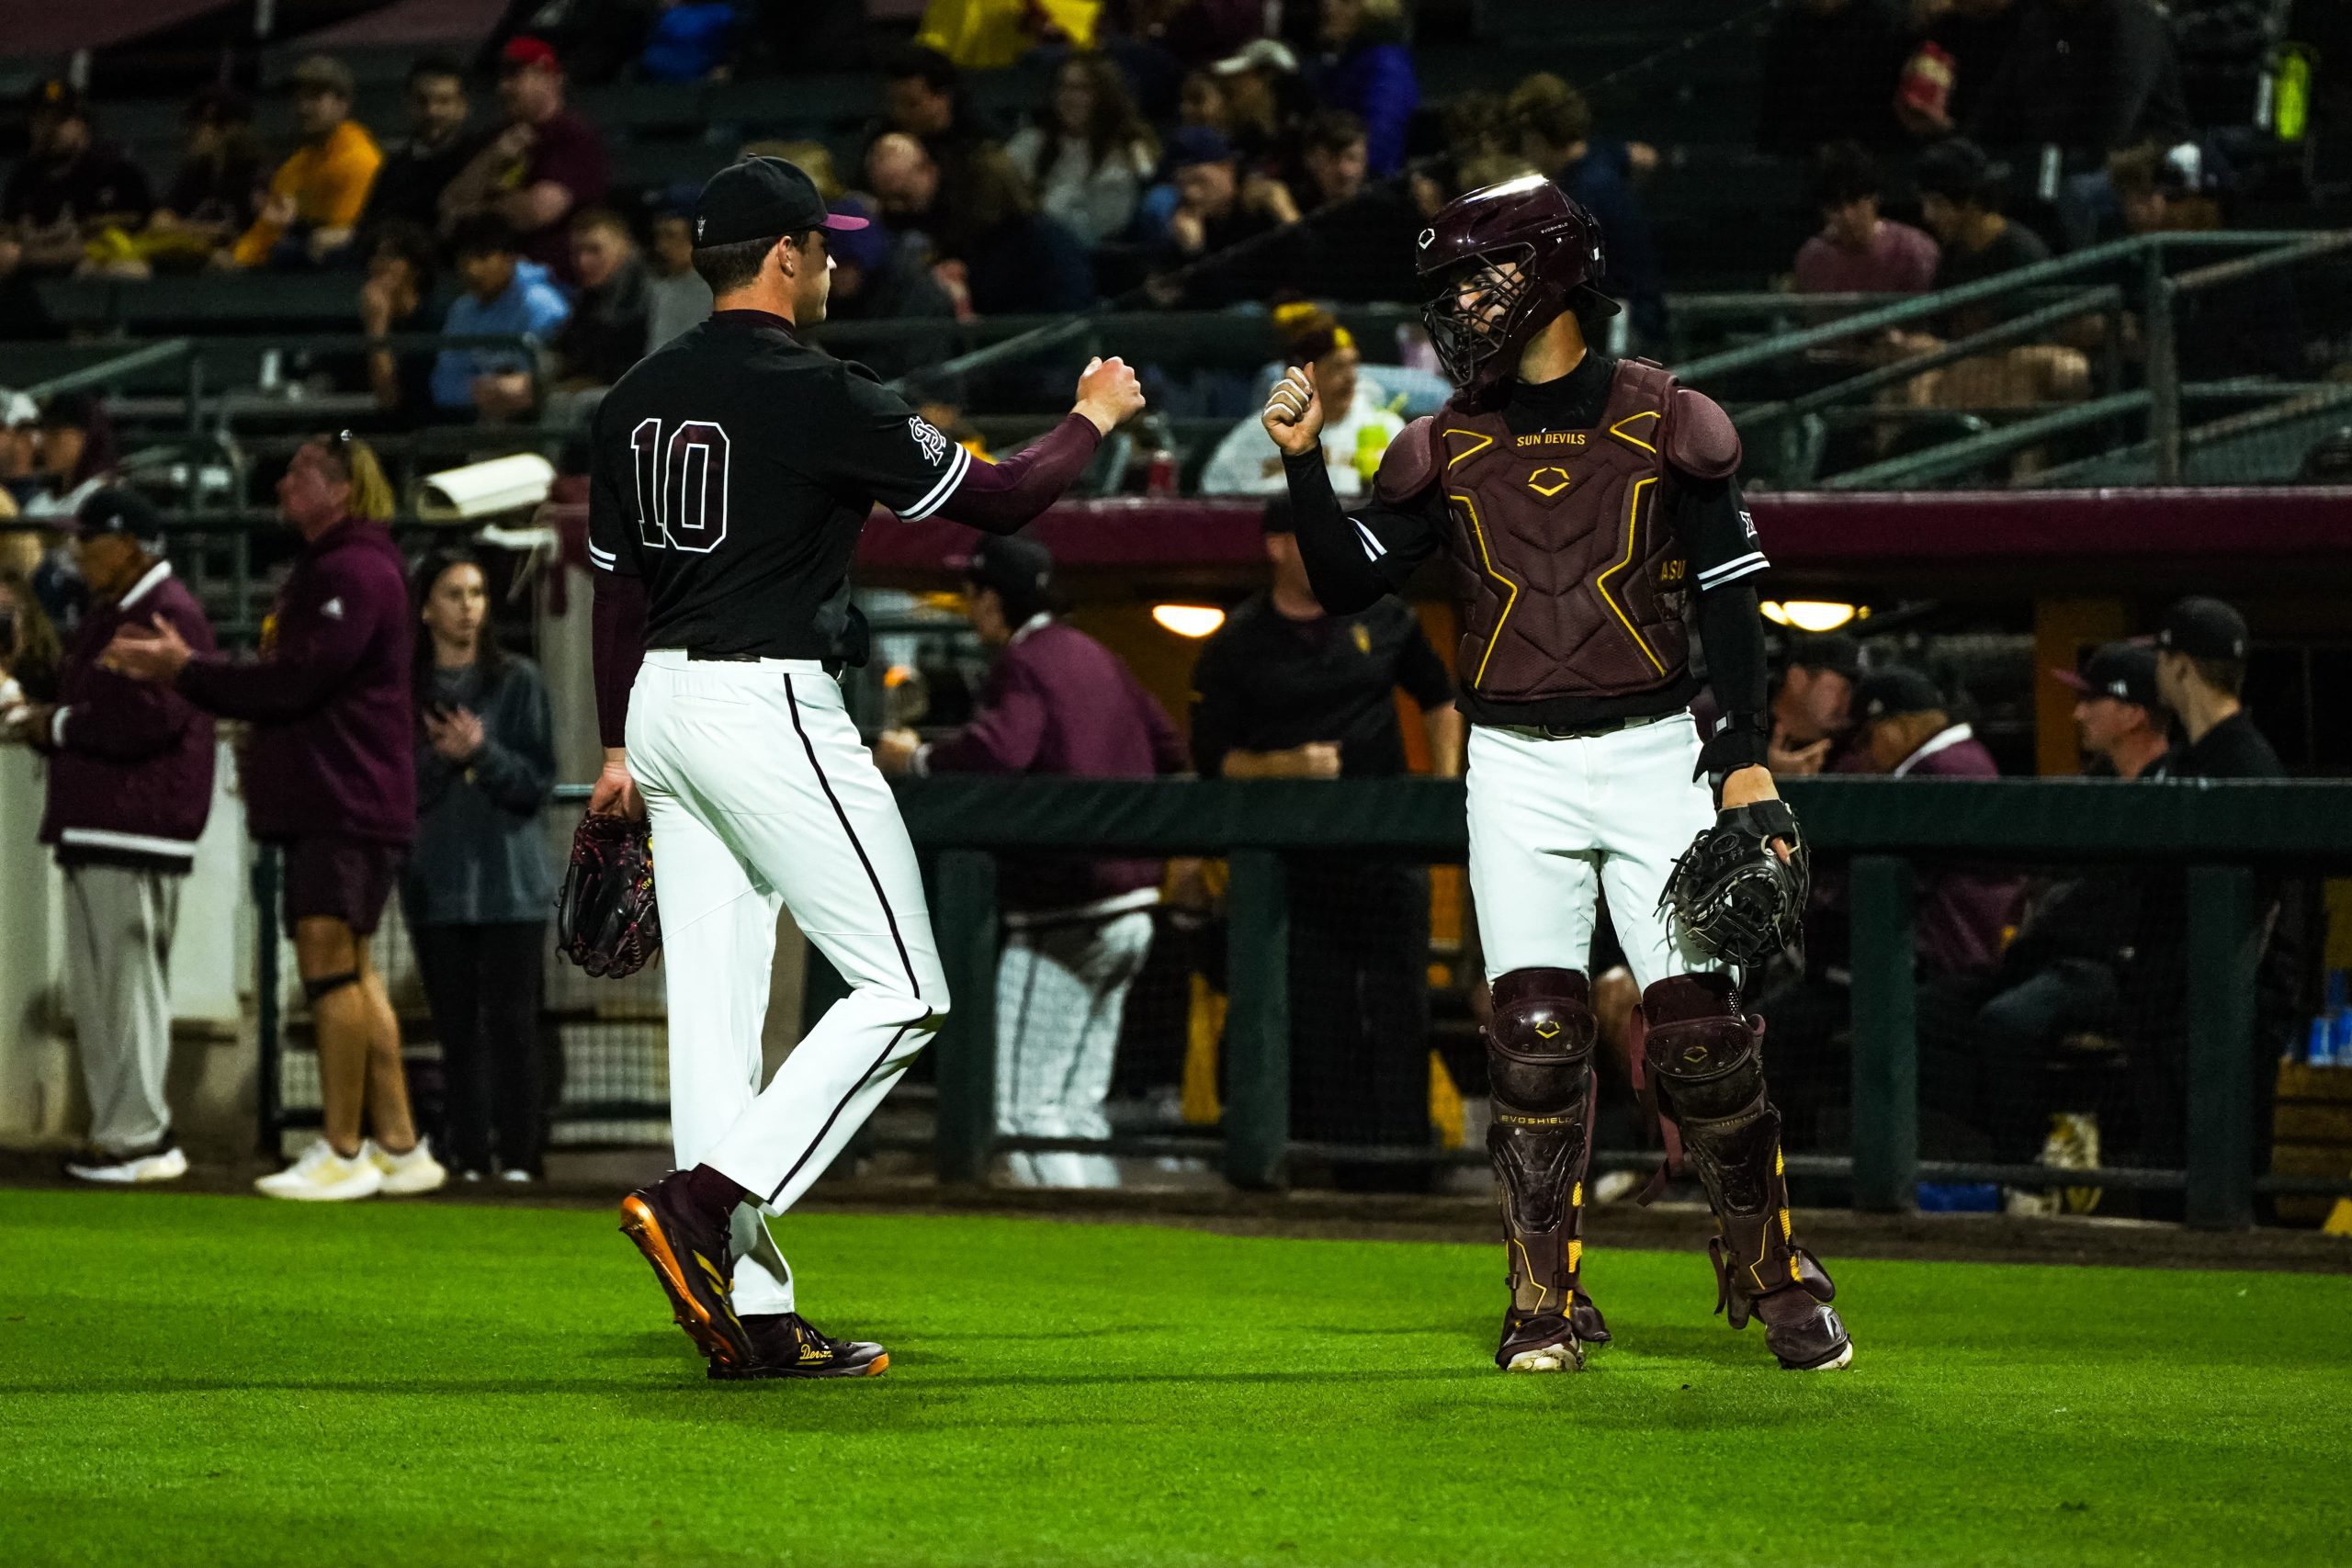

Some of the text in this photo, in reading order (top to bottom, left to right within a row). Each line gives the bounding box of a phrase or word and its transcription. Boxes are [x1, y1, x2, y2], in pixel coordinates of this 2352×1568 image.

[1517, 433, 1586, 446] SUN DEVILS
[630, 418, 730, 553] 10
[1661, 559, 1687, 581] ASU
